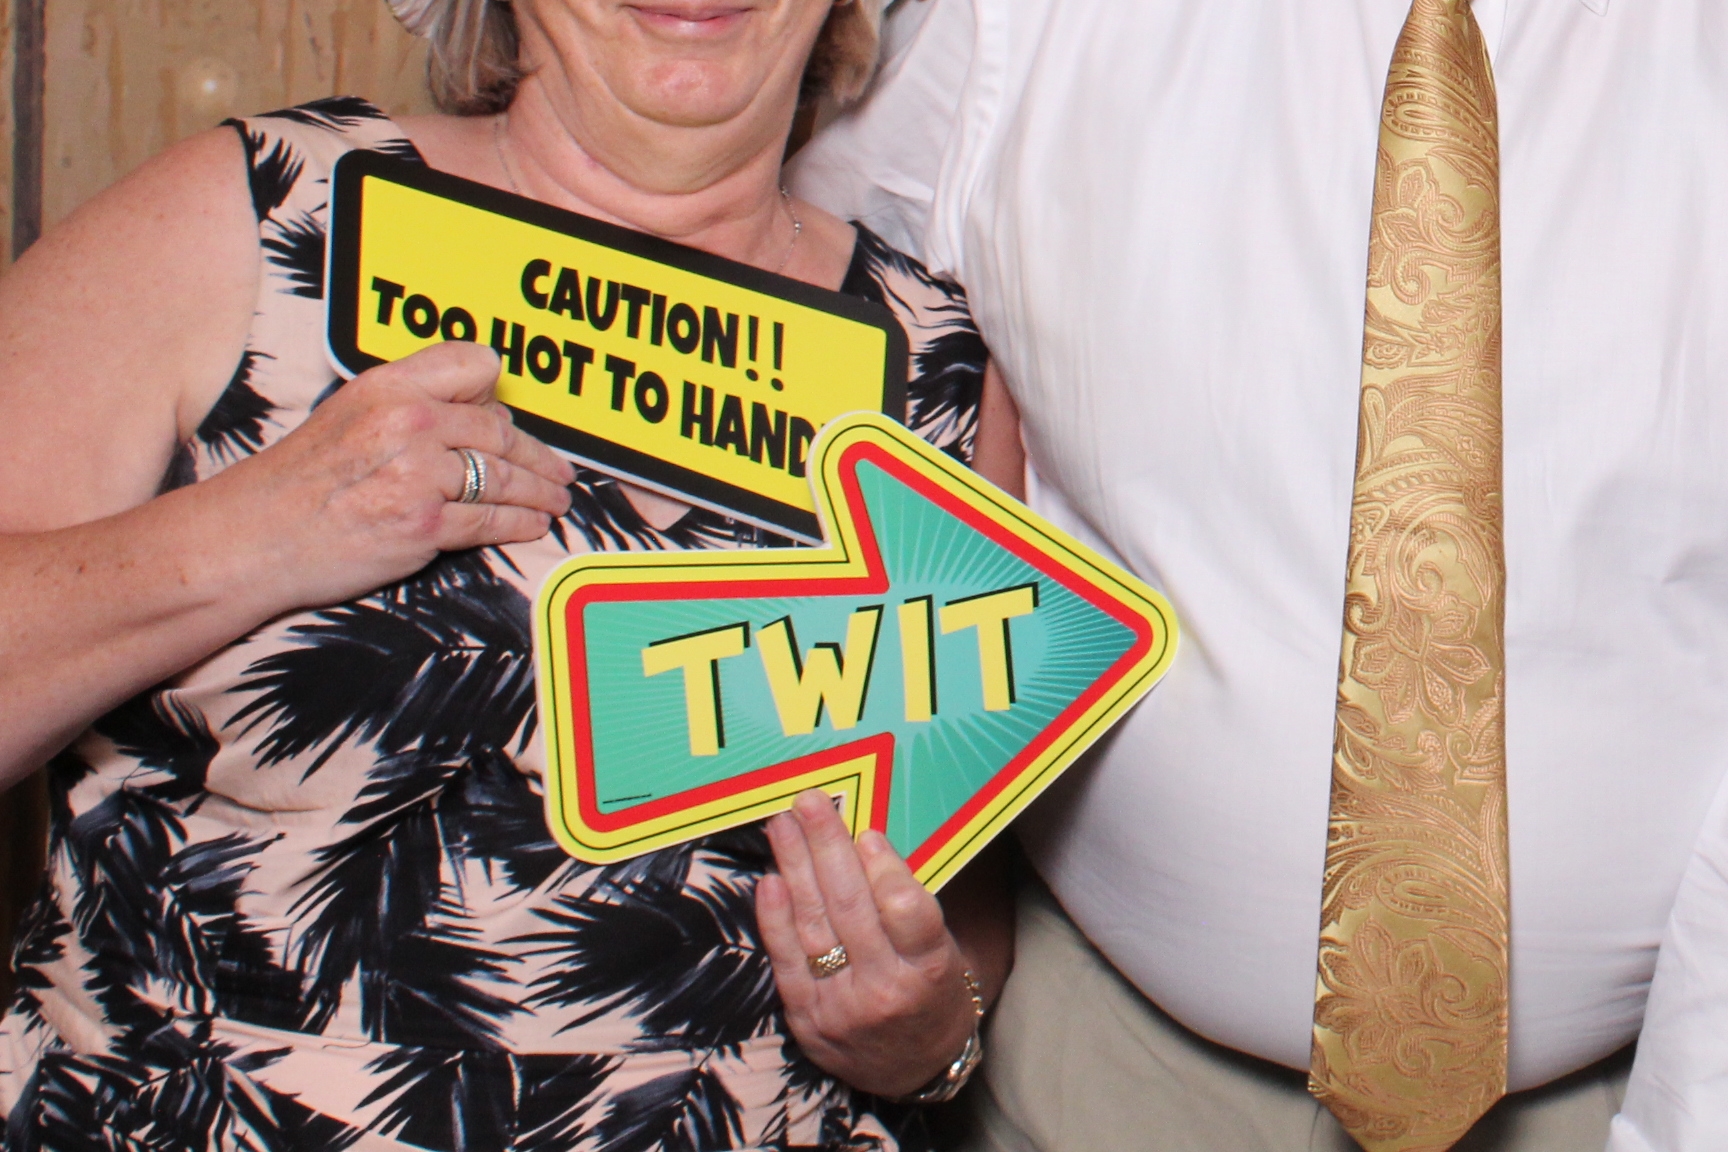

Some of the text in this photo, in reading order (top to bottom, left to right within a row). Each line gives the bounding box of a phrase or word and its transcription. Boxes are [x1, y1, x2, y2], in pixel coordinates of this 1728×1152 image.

[371, 275, 824, 478] TOO HOT TO HAND
[520, 258, 785, 392] CAUTION!!
[640, 581, 1039, 757] TWIT
